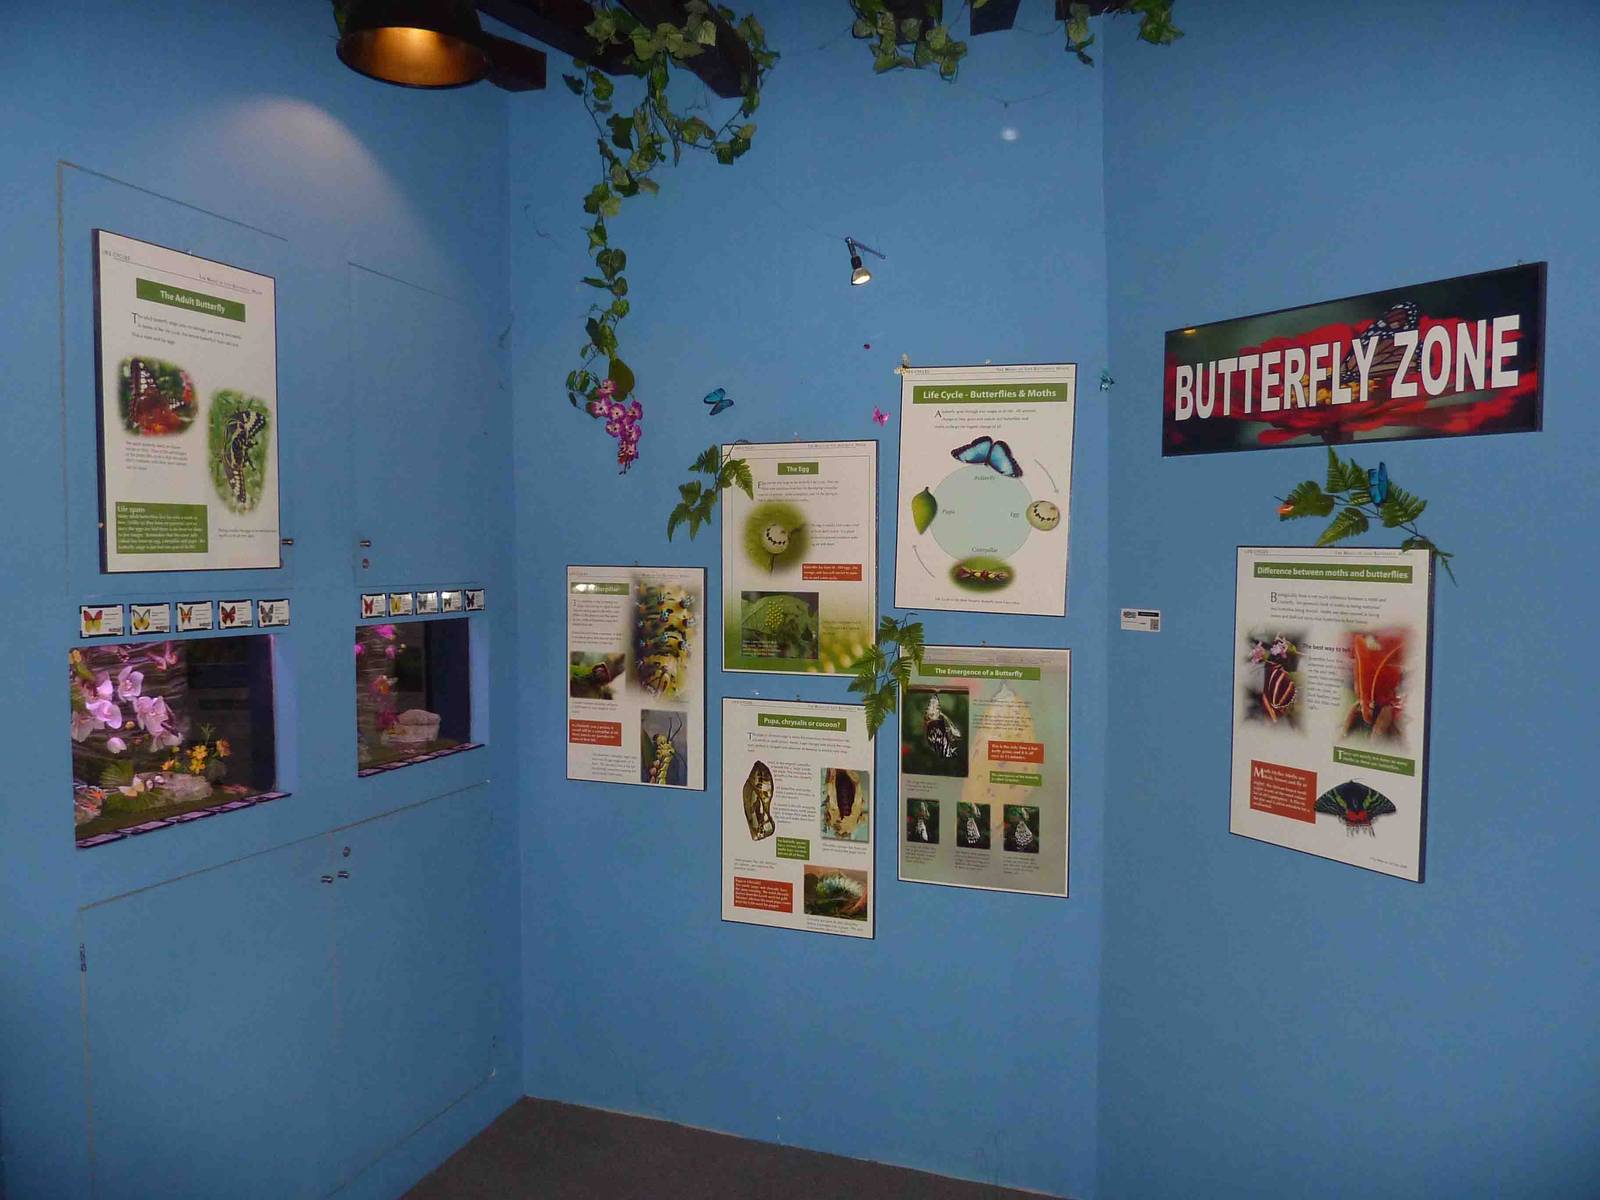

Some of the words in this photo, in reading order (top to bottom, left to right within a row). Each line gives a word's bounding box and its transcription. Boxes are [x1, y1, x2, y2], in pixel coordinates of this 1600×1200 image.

[160, 290, 174, 302] The
[175, 293, 195, 307] Adult
[196, 297, 226, 314] Butterfly
[1175, 336, 1379, 421] BUTTERFLY
[1391, 314, 1520, 399] ZONE
[923, 391, 939, 399] Life
[941, 390, 964, 401] Cycle
[970, 389, 1017, 399] Butterflies
[1018, 390, 1025, 398] &
[1027, 388, 1056, 398] Moths
[798, 466, 810, 474] Egg
[1257, 567, 1292, 576] Difference
[1293, 568, 1324, 577] between
[1325, 569, 1349, 578] moths
[1350, 570, 1365, 578] and
[1366, 570, 1409, 580] butterflies
[935, 667, 947, 675] The
[947, 668, 981, 677] Emergence
[995, 670, 1023, 678] Butterfly
[763, 717, 781, 727] Pupa,
[781, 718, 807, 729] chrysalis
[815, 720, 840, 729] cocoon?
